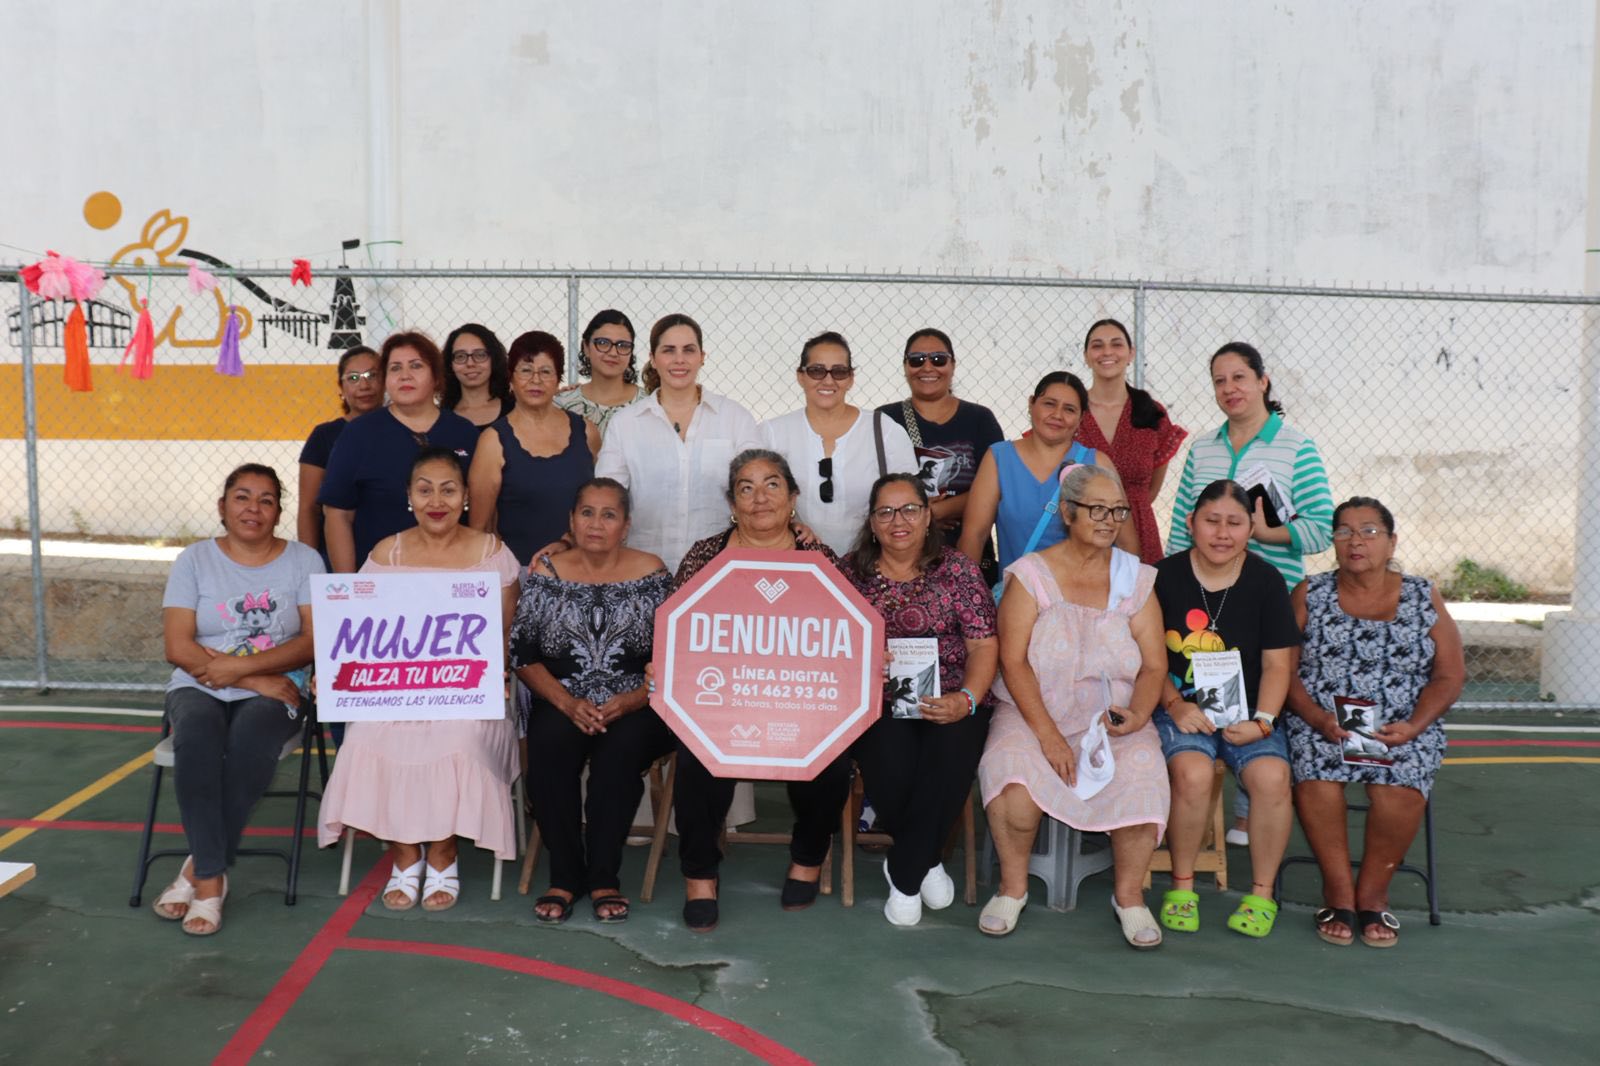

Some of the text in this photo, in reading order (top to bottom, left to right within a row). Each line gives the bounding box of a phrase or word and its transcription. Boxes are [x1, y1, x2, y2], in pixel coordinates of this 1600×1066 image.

[330, 613, 488, 661] MUJER
[688, 612, 853, 659] DENUNCIA
[350, 664, 471, 687] ¡ALZA TU VOZ!
[732, 665, 839, 684] LÍNEA DIGITAL
[335, 694, 486, 708] DETENGAMOS LAS VIOLENCIAS
[732, 683, 838, 700] 961 462 93 40
[731, 698, 743, 707] 24
[775, 701, 801, 711] todos
[803, 702, 816, 711] los
